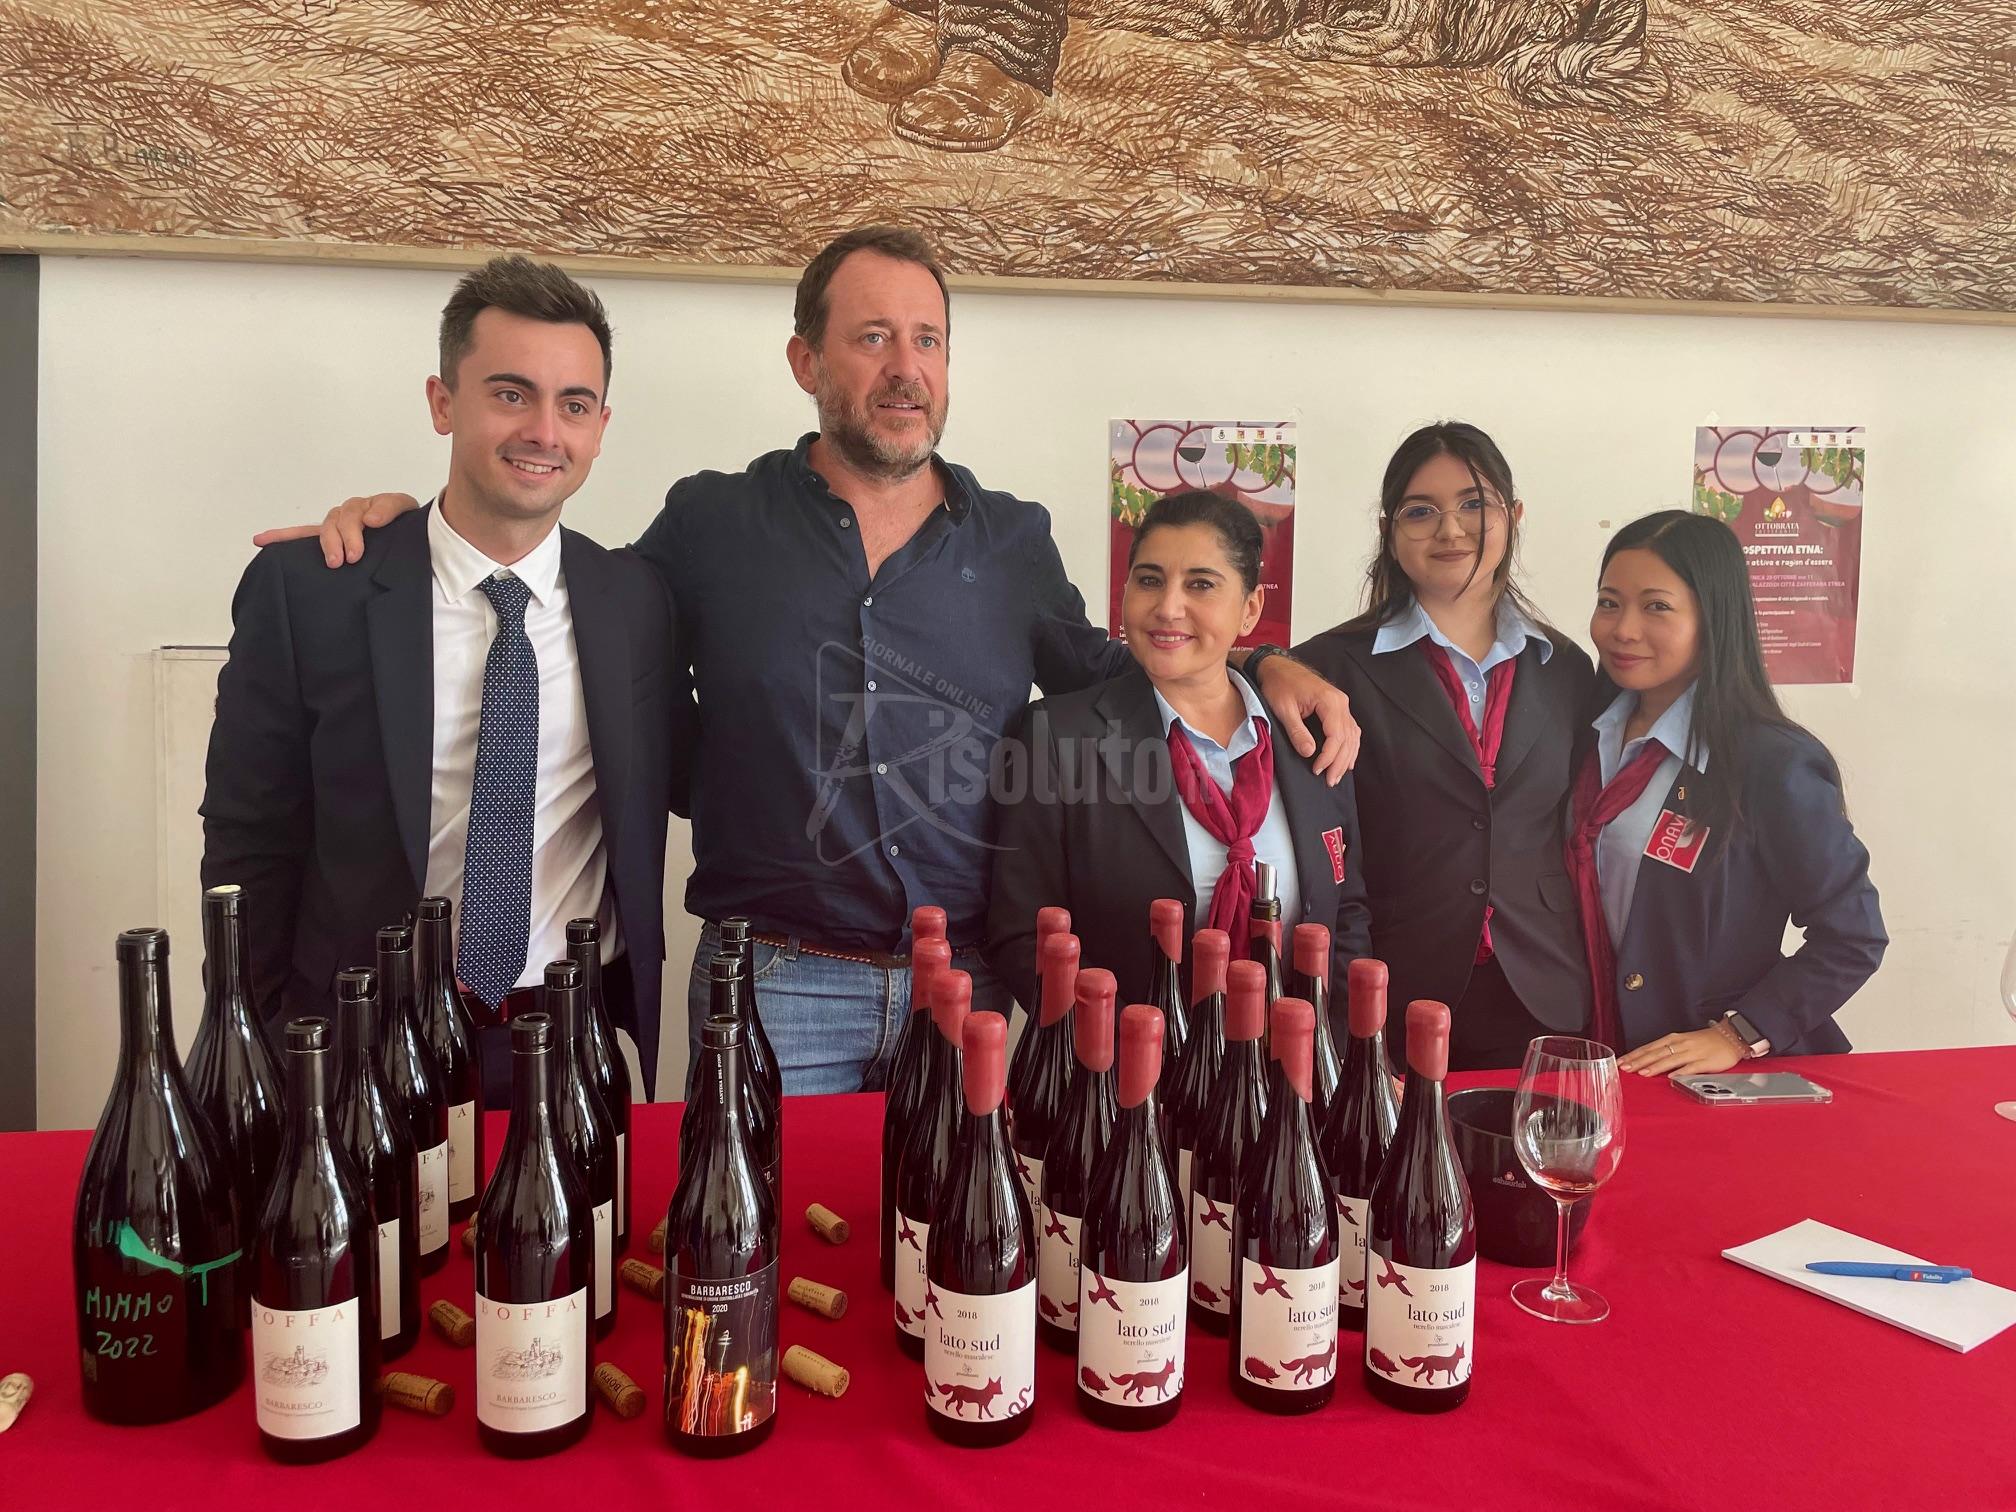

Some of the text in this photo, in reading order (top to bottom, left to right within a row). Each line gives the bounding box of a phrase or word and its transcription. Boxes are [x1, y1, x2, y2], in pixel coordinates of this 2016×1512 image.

[1755, 522, 1799, 530] OTTOBRATA
[1743, 545, 1824, 555] OSPETTIVA ETNA:
[690, 1281, 751, 1296] BARBARESCO
[1308, 1281, 1325, 1292] 2018
[1428, 1284, 1449, 1293] 2018
[86, 1286, 173, 1322] MIMMO
[712, 1304, 728, 1312] 2020
[1139, 1298, 1159, 1306] 2018
[481, 1299, 577, 1321] BOFFA
[957, 1310, 977, 1320] 2018
[1288, 1307, 1316, 1323] lato
[1408, 1302, 1465, 1322] lato sud
[1118, 1314, 1175, 1337] lato sud
[96, 1331, 157, 1360] 2022
[940, 1327, 1000, 1352] lato sud
[265, 1397, 323, 1410] BARBARESCO
[496, 1391, 556, 1404] BARBARESCO
